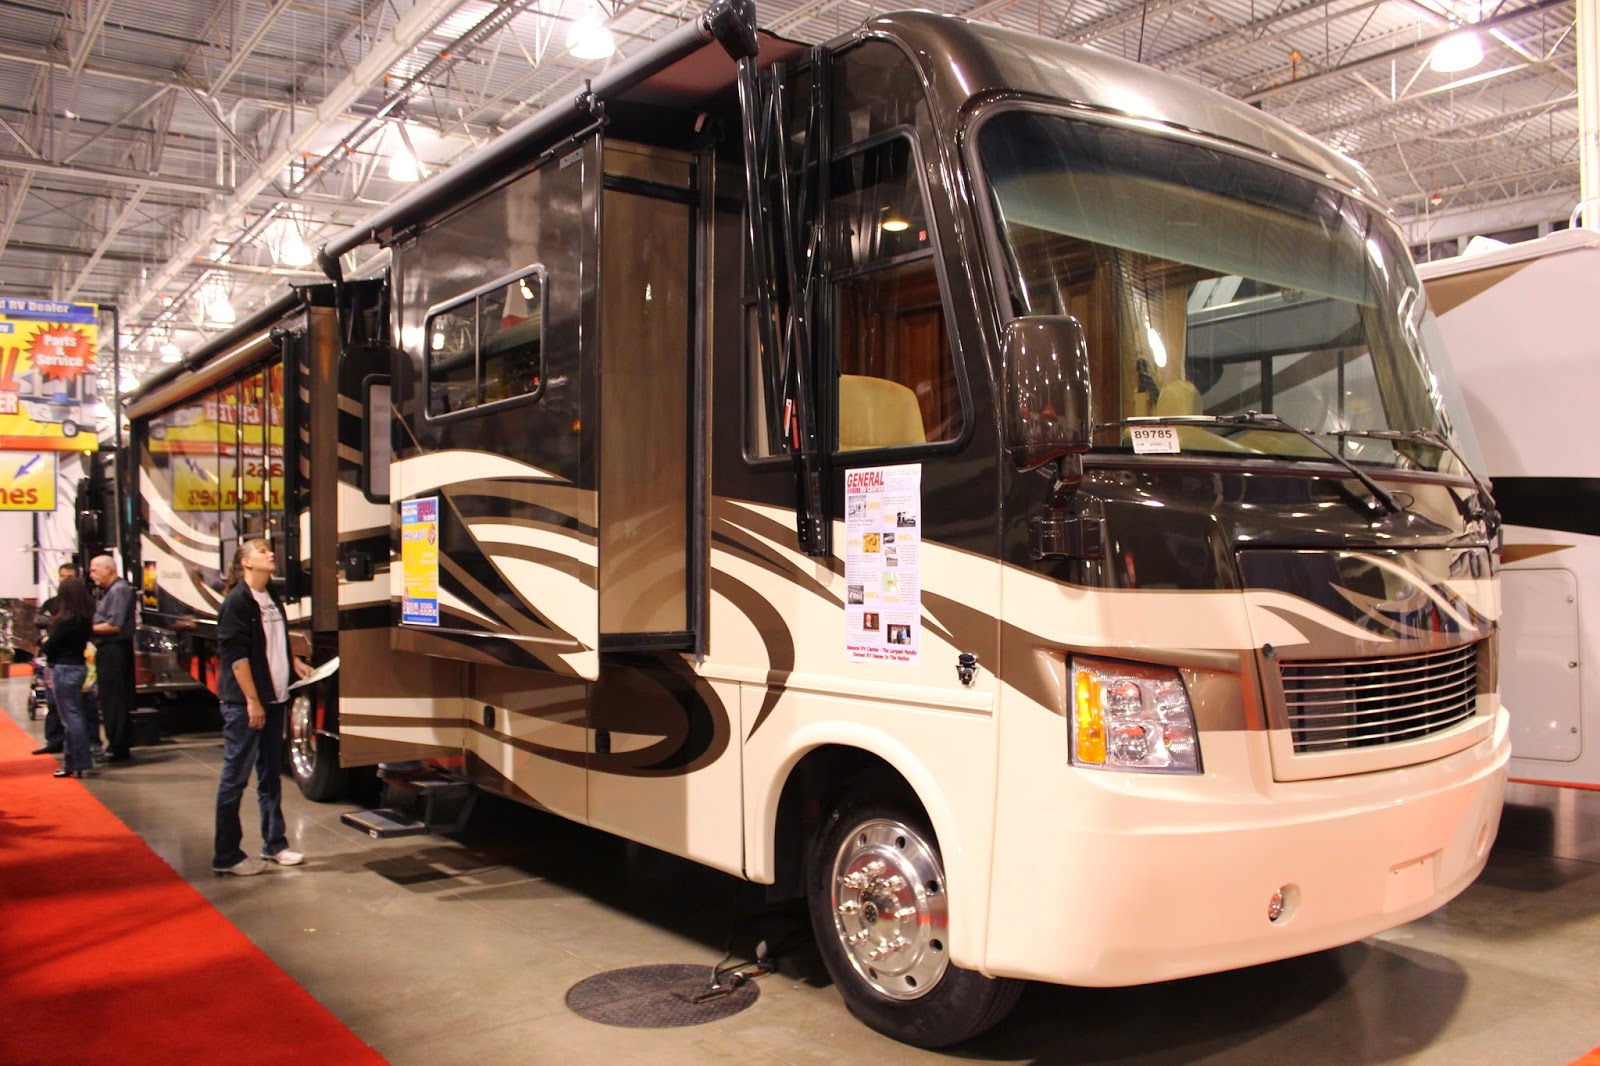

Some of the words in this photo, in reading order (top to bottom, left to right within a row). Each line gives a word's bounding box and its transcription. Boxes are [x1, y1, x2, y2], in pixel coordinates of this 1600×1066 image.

[9, 301, 26, 311] RV
[28, 302, 70, 313] Dealer
[43, 334, 77, 347] Parts
[55, 346, 65, 356] &
[36, 354, 84, 367] Service
[1134, 430, 1173, 439] 89785
[847, 471, 885, 488] GENERAL
